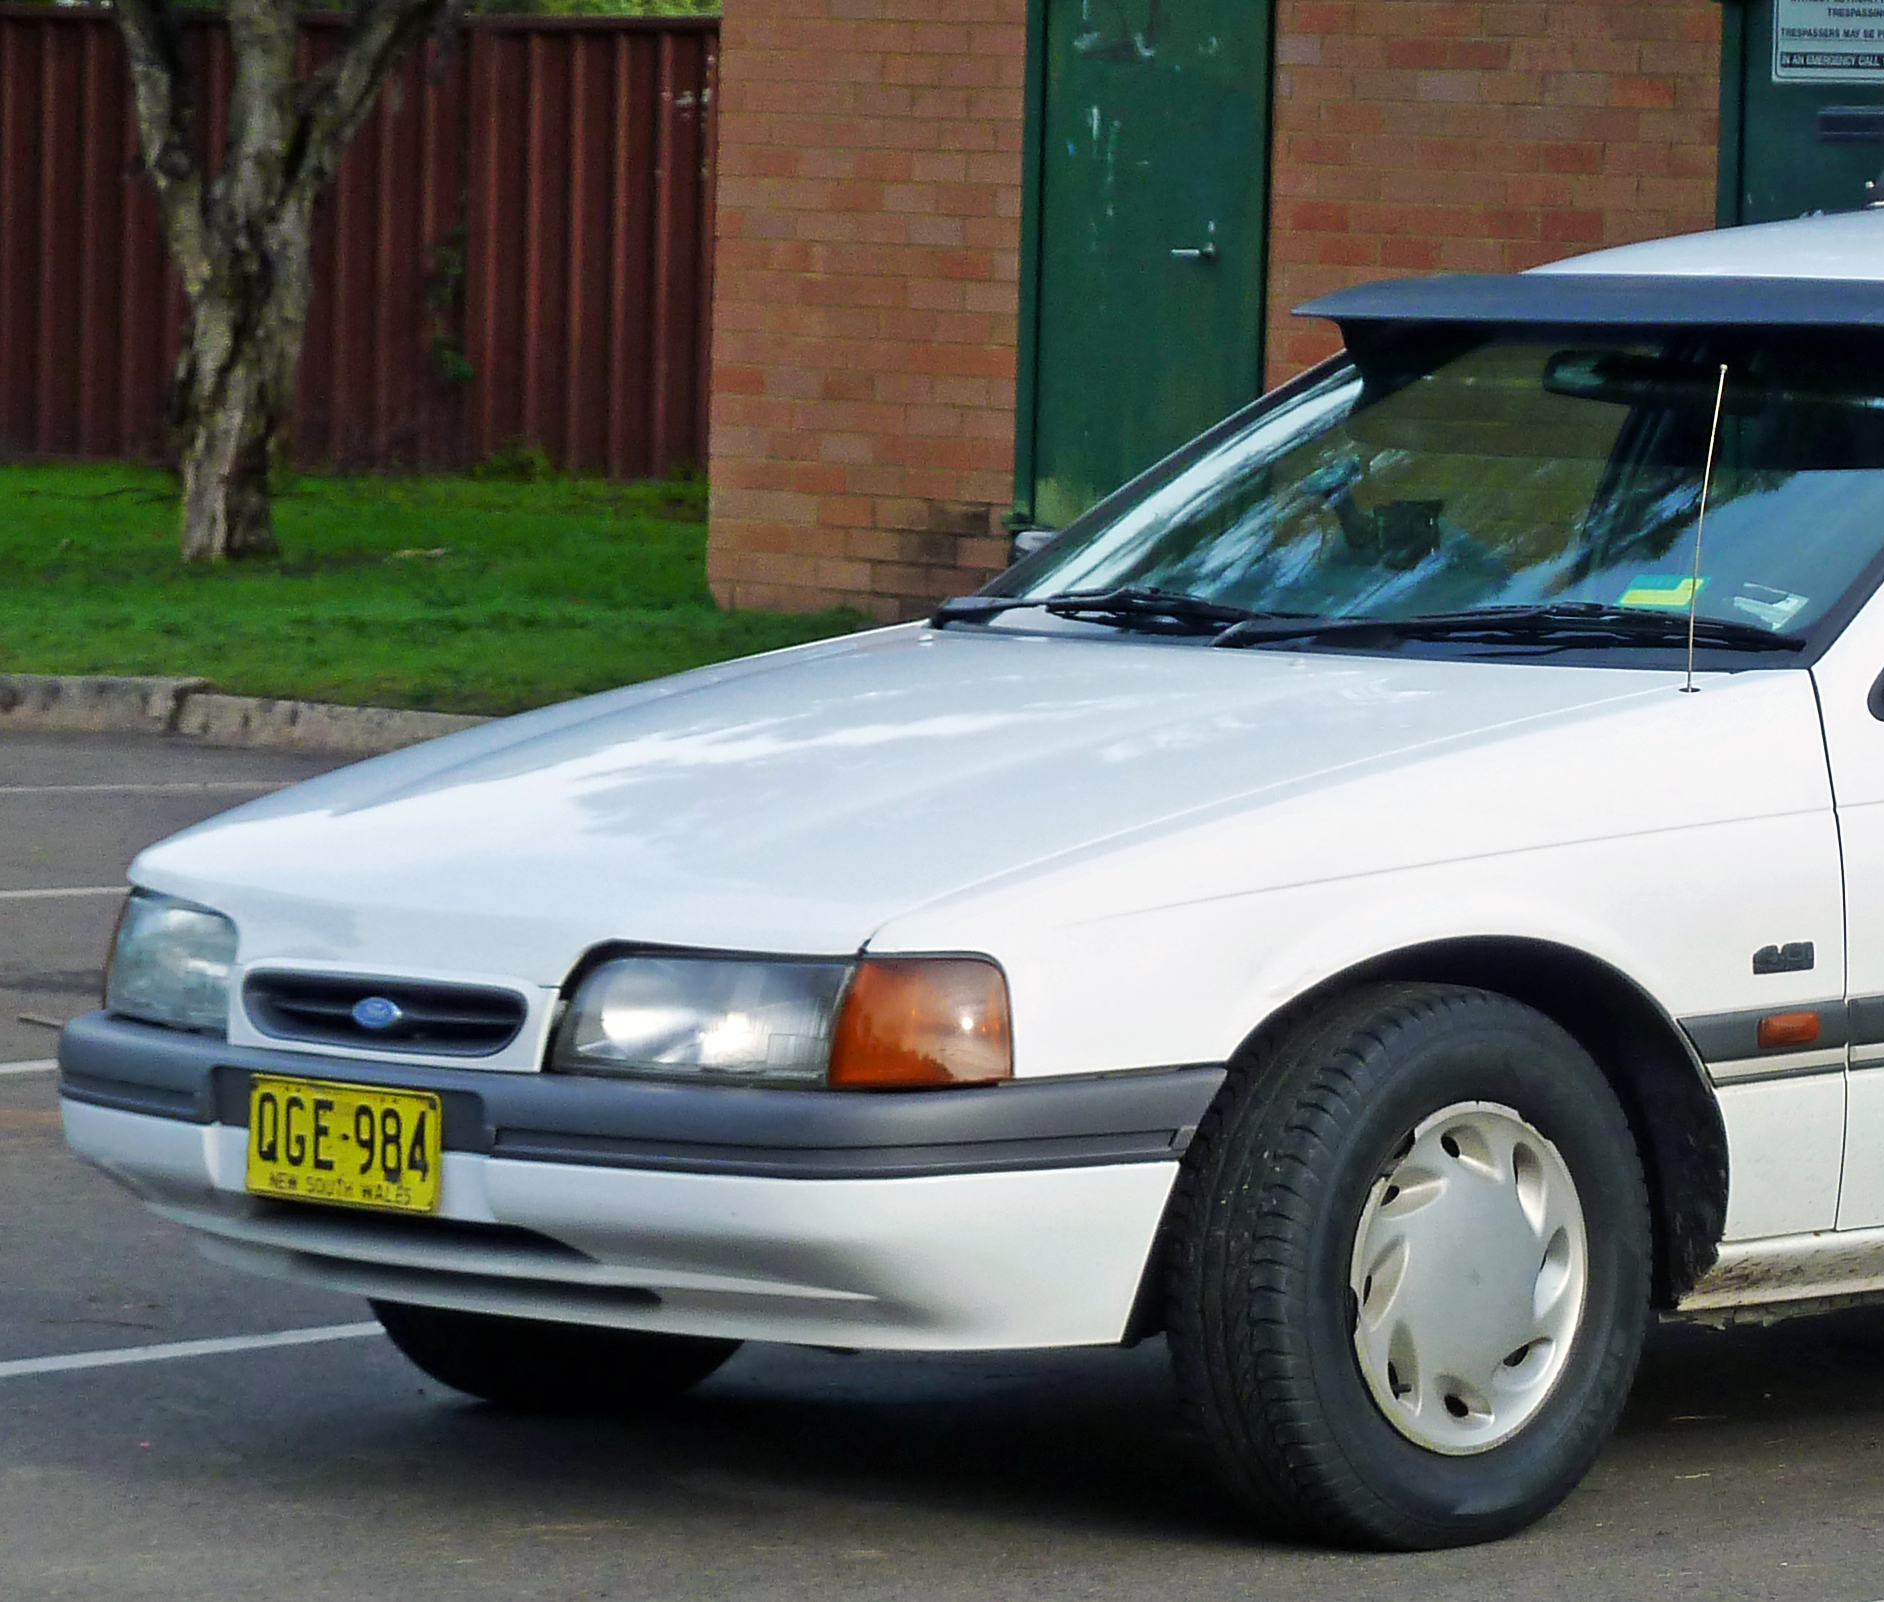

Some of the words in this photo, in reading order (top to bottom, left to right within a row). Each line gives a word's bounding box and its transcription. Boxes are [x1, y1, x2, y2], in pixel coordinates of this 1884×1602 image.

[1780, 27, 1840, 38] TRESPASSERS
[1843, 28, 1860, 38] MAY
[1863, 29, 1875, 39] BE
[1792, 54, 1805, 65] AN
[1806, 54, 1855, 65] EMERGENCY
[1858, 55, 1880, 66] CALL
[269, 1171, 298, 1190] NEW
[305, 1175, 354, 1197] SOUTH
[359, 1182, 412, 1205] WALES
